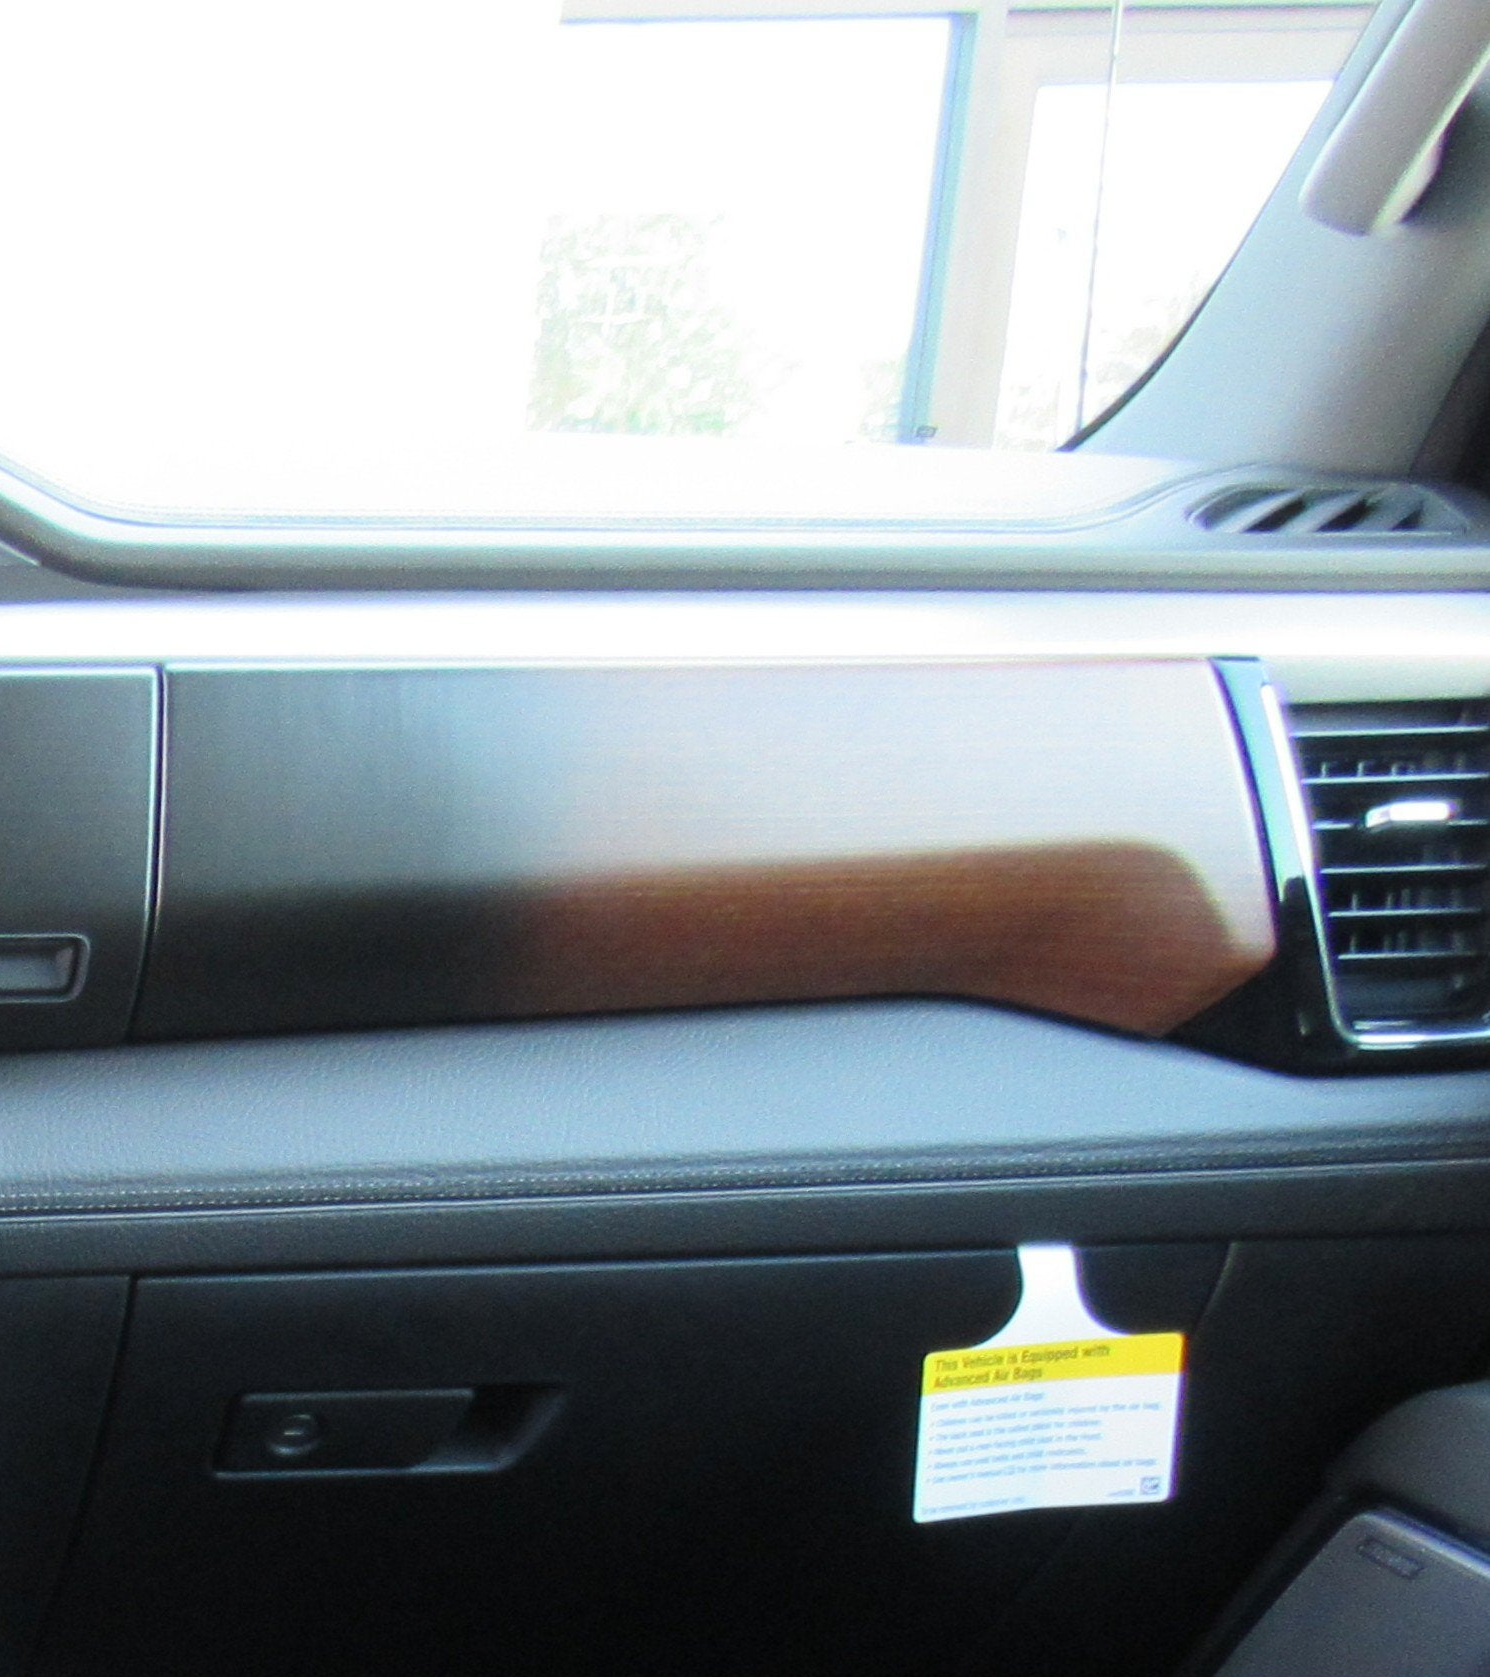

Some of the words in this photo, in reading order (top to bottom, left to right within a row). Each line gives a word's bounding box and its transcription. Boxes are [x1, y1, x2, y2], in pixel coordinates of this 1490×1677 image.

[962, 1355, 1004, 1369] Vehicle
[1021, 1346, 1078, 1364] Equipped
[934, 1370, 990, 1388] Advanced
[993, 1368, 1009, 1381] Air
[1013, 1366, 1043, 1381] Bags
